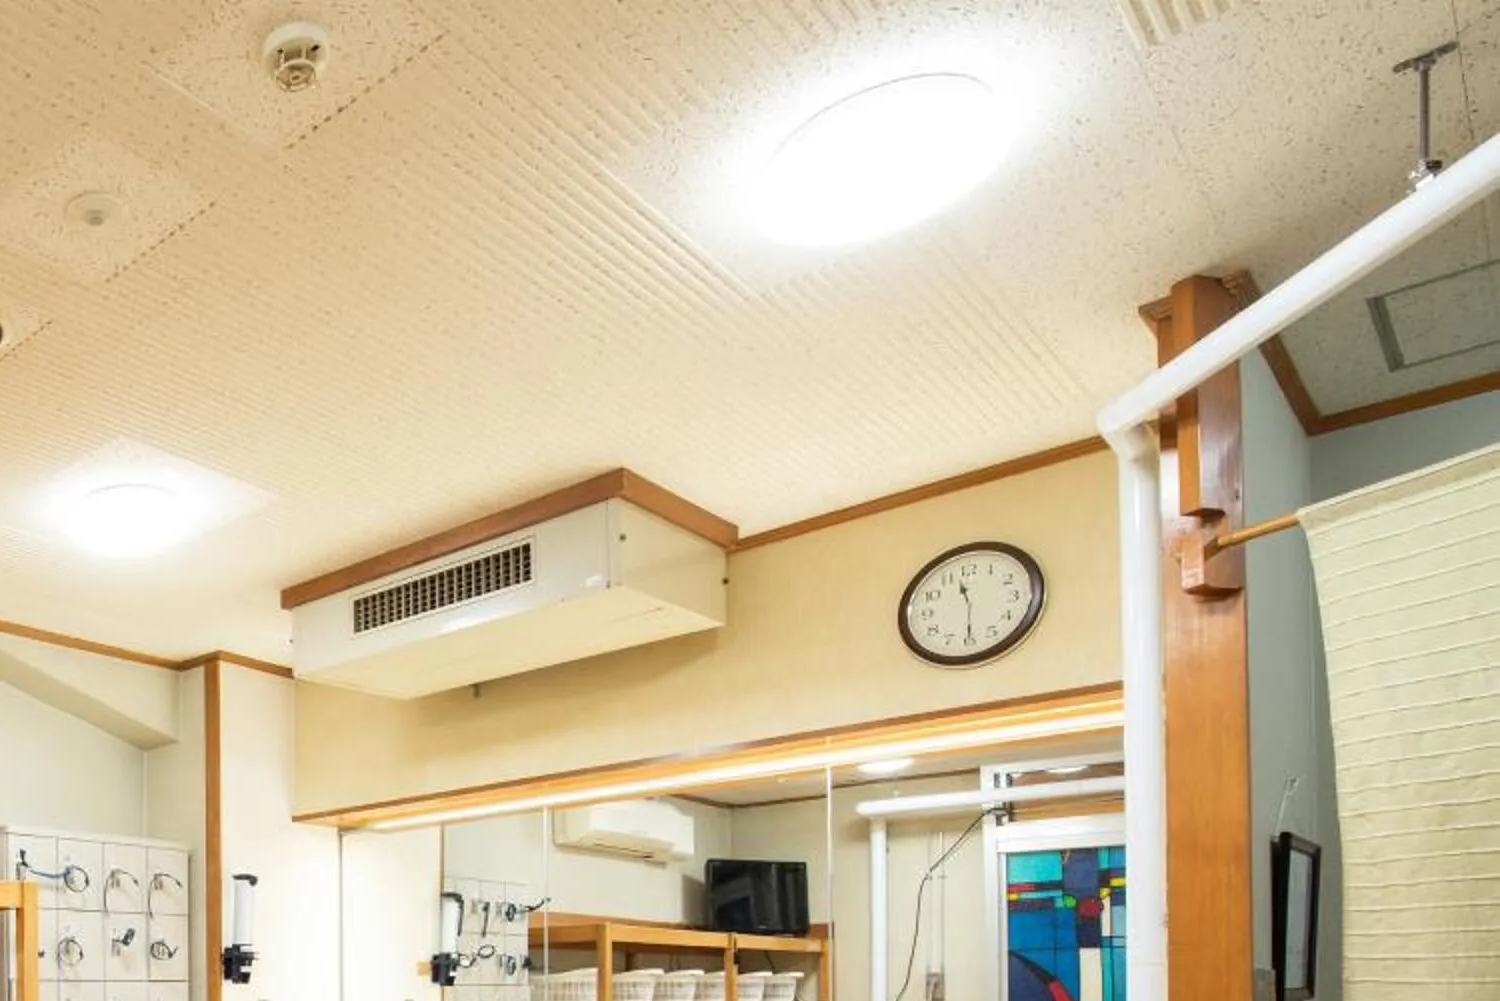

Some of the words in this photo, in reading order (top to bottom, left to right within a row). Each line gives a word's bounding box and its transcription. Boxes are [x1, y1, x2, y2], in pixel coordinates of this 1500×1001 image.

[961, 563, 977, 577] 12
[988, 563, 994, 575] 1
[941, 571, 953, 586] 11
[1002, 573, 1013, 585] 2
[925, 590, 941, 602] 10
[1008, 590, 1020, 602] 3
[920, 608, 934, 620] 9
[1000, 609, 1012, 621] 4
[927, 624, 939, 636] 8
[985, 625, 998, 638] 5
[945, 633, 955, 645] 7
